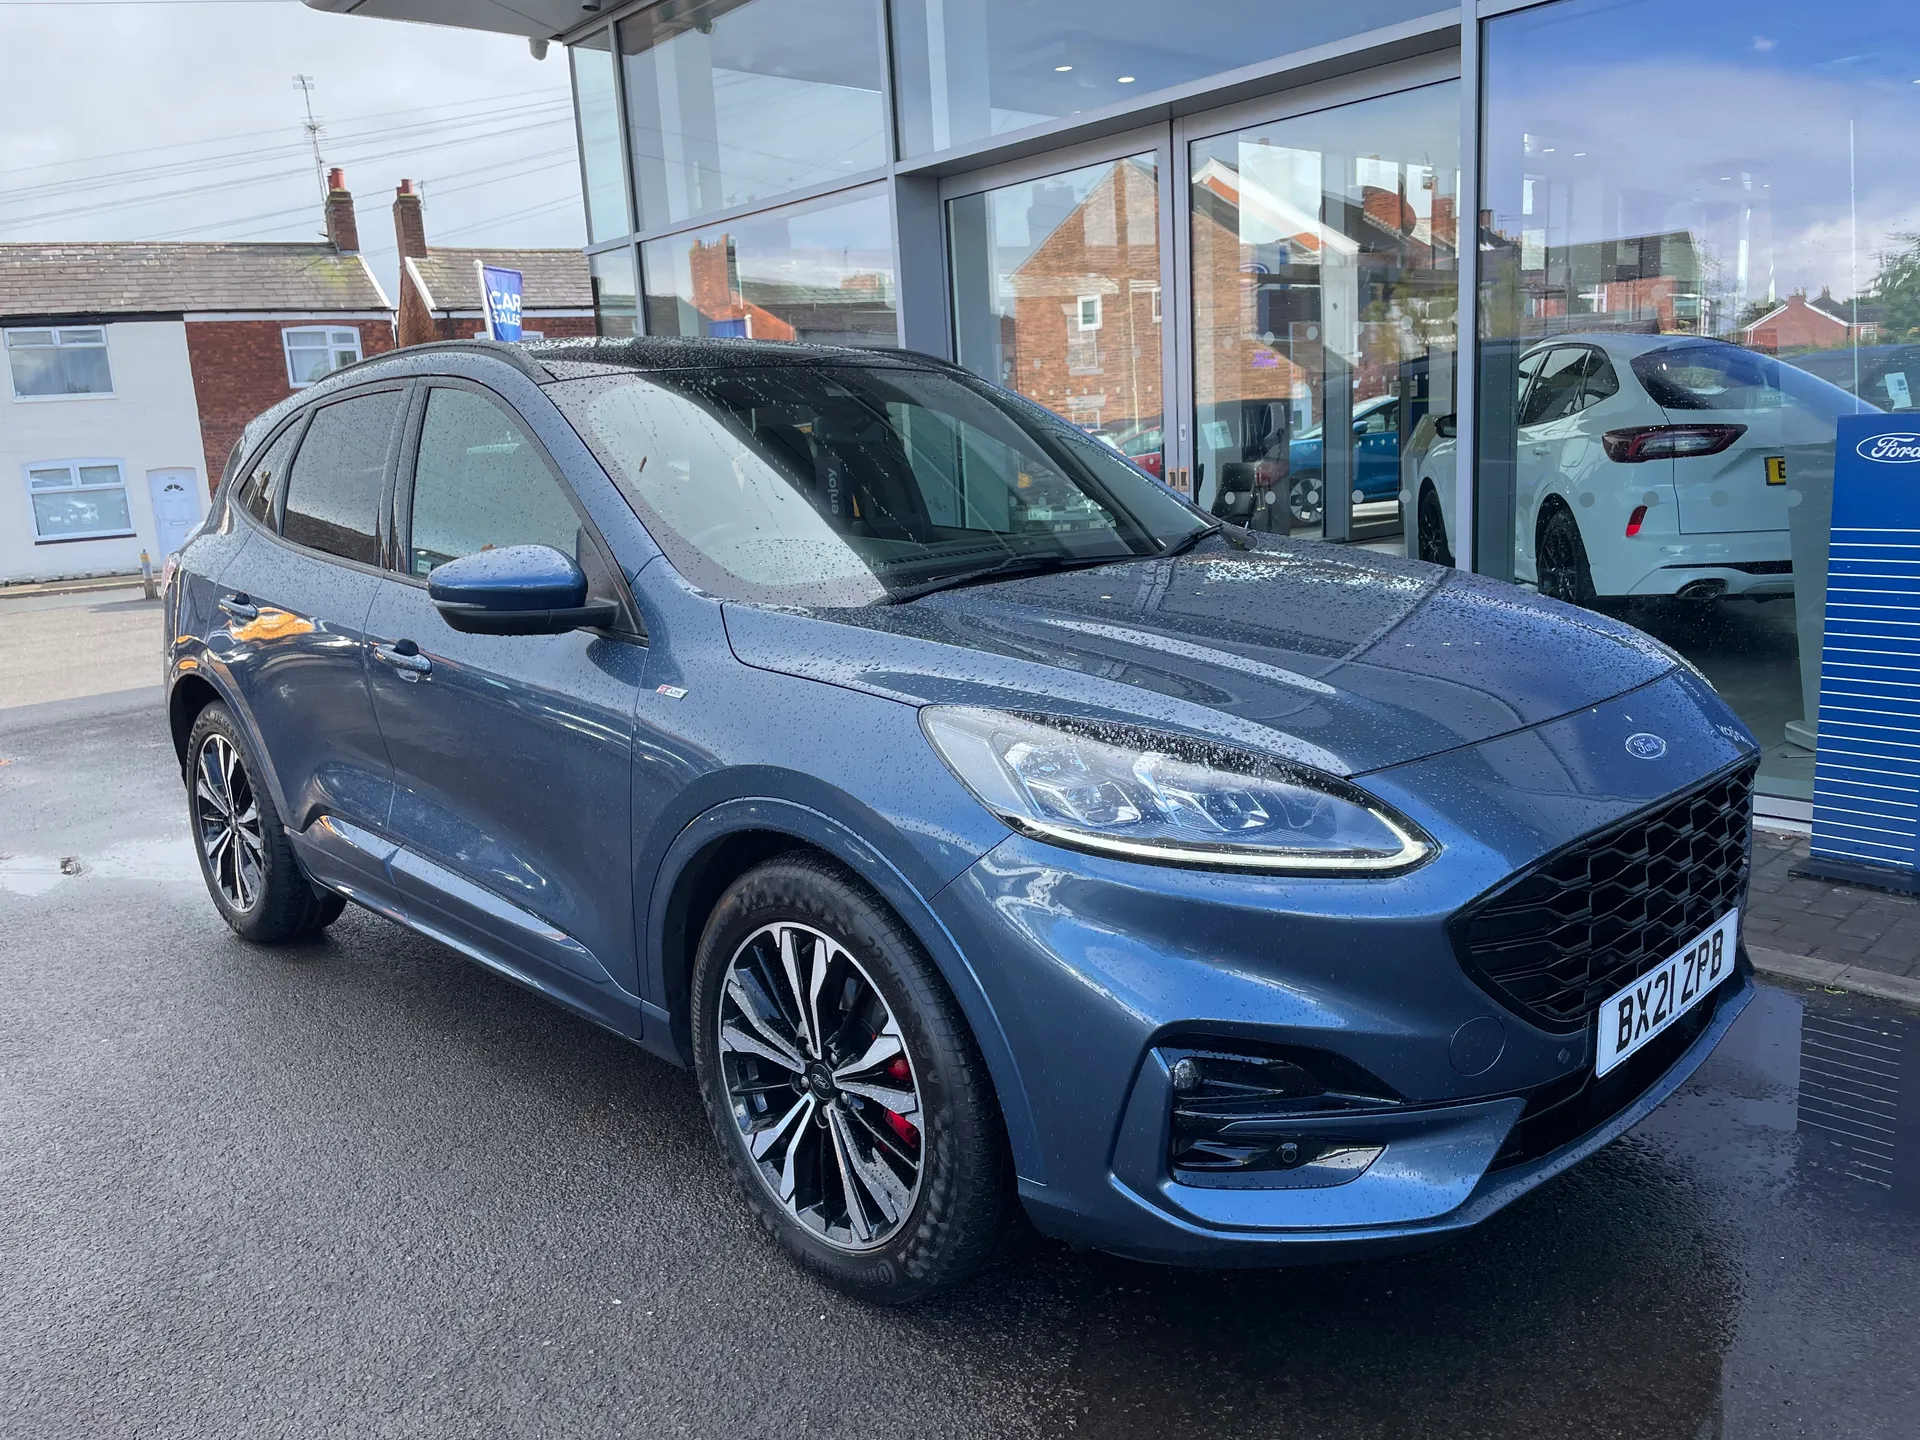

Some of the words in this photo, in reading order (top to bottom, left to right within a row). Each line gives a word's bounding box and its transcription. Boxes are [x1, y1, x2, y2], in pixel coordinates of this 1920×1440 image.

[489, 290, 521, 313] CAR
[492, 311, 520, 326] SALES
[828, 468, 839, 514] enjoy
[1616, 963, 1676, 1055] BX21
[1681, 928, 1724, 1006] ZPB
